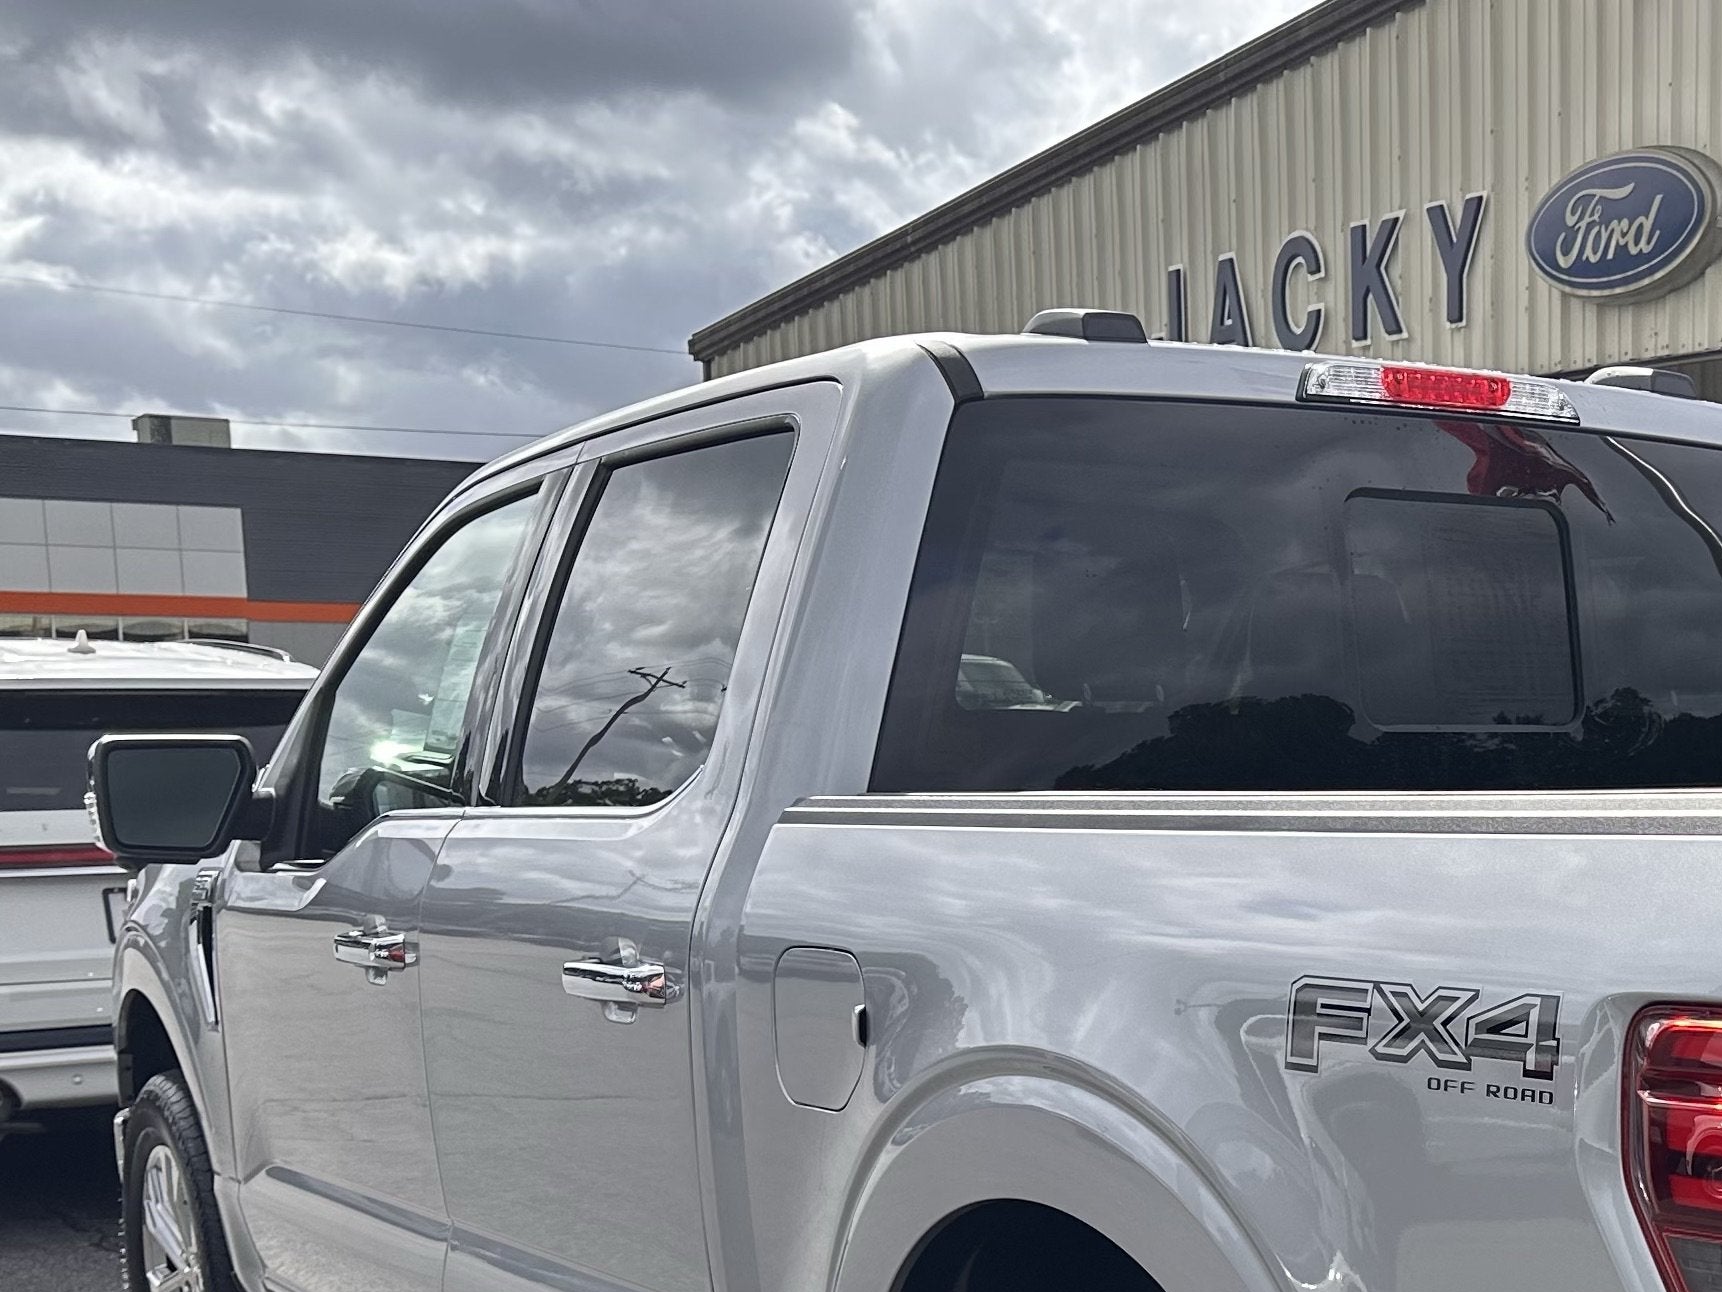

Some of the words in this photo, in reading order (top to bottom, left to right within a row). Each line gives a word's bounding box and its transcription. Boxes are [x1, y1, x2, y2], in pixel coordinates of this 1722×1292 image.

[1150, 190, 1488, 352] JACKY
[1555, 182, 1663, 269] Ford
[1284, 975, 1563, 1081] FX4
[1427, 1077, 1476, 1094] OFF
[1486, 1083, 1554, 1105] ROAD
